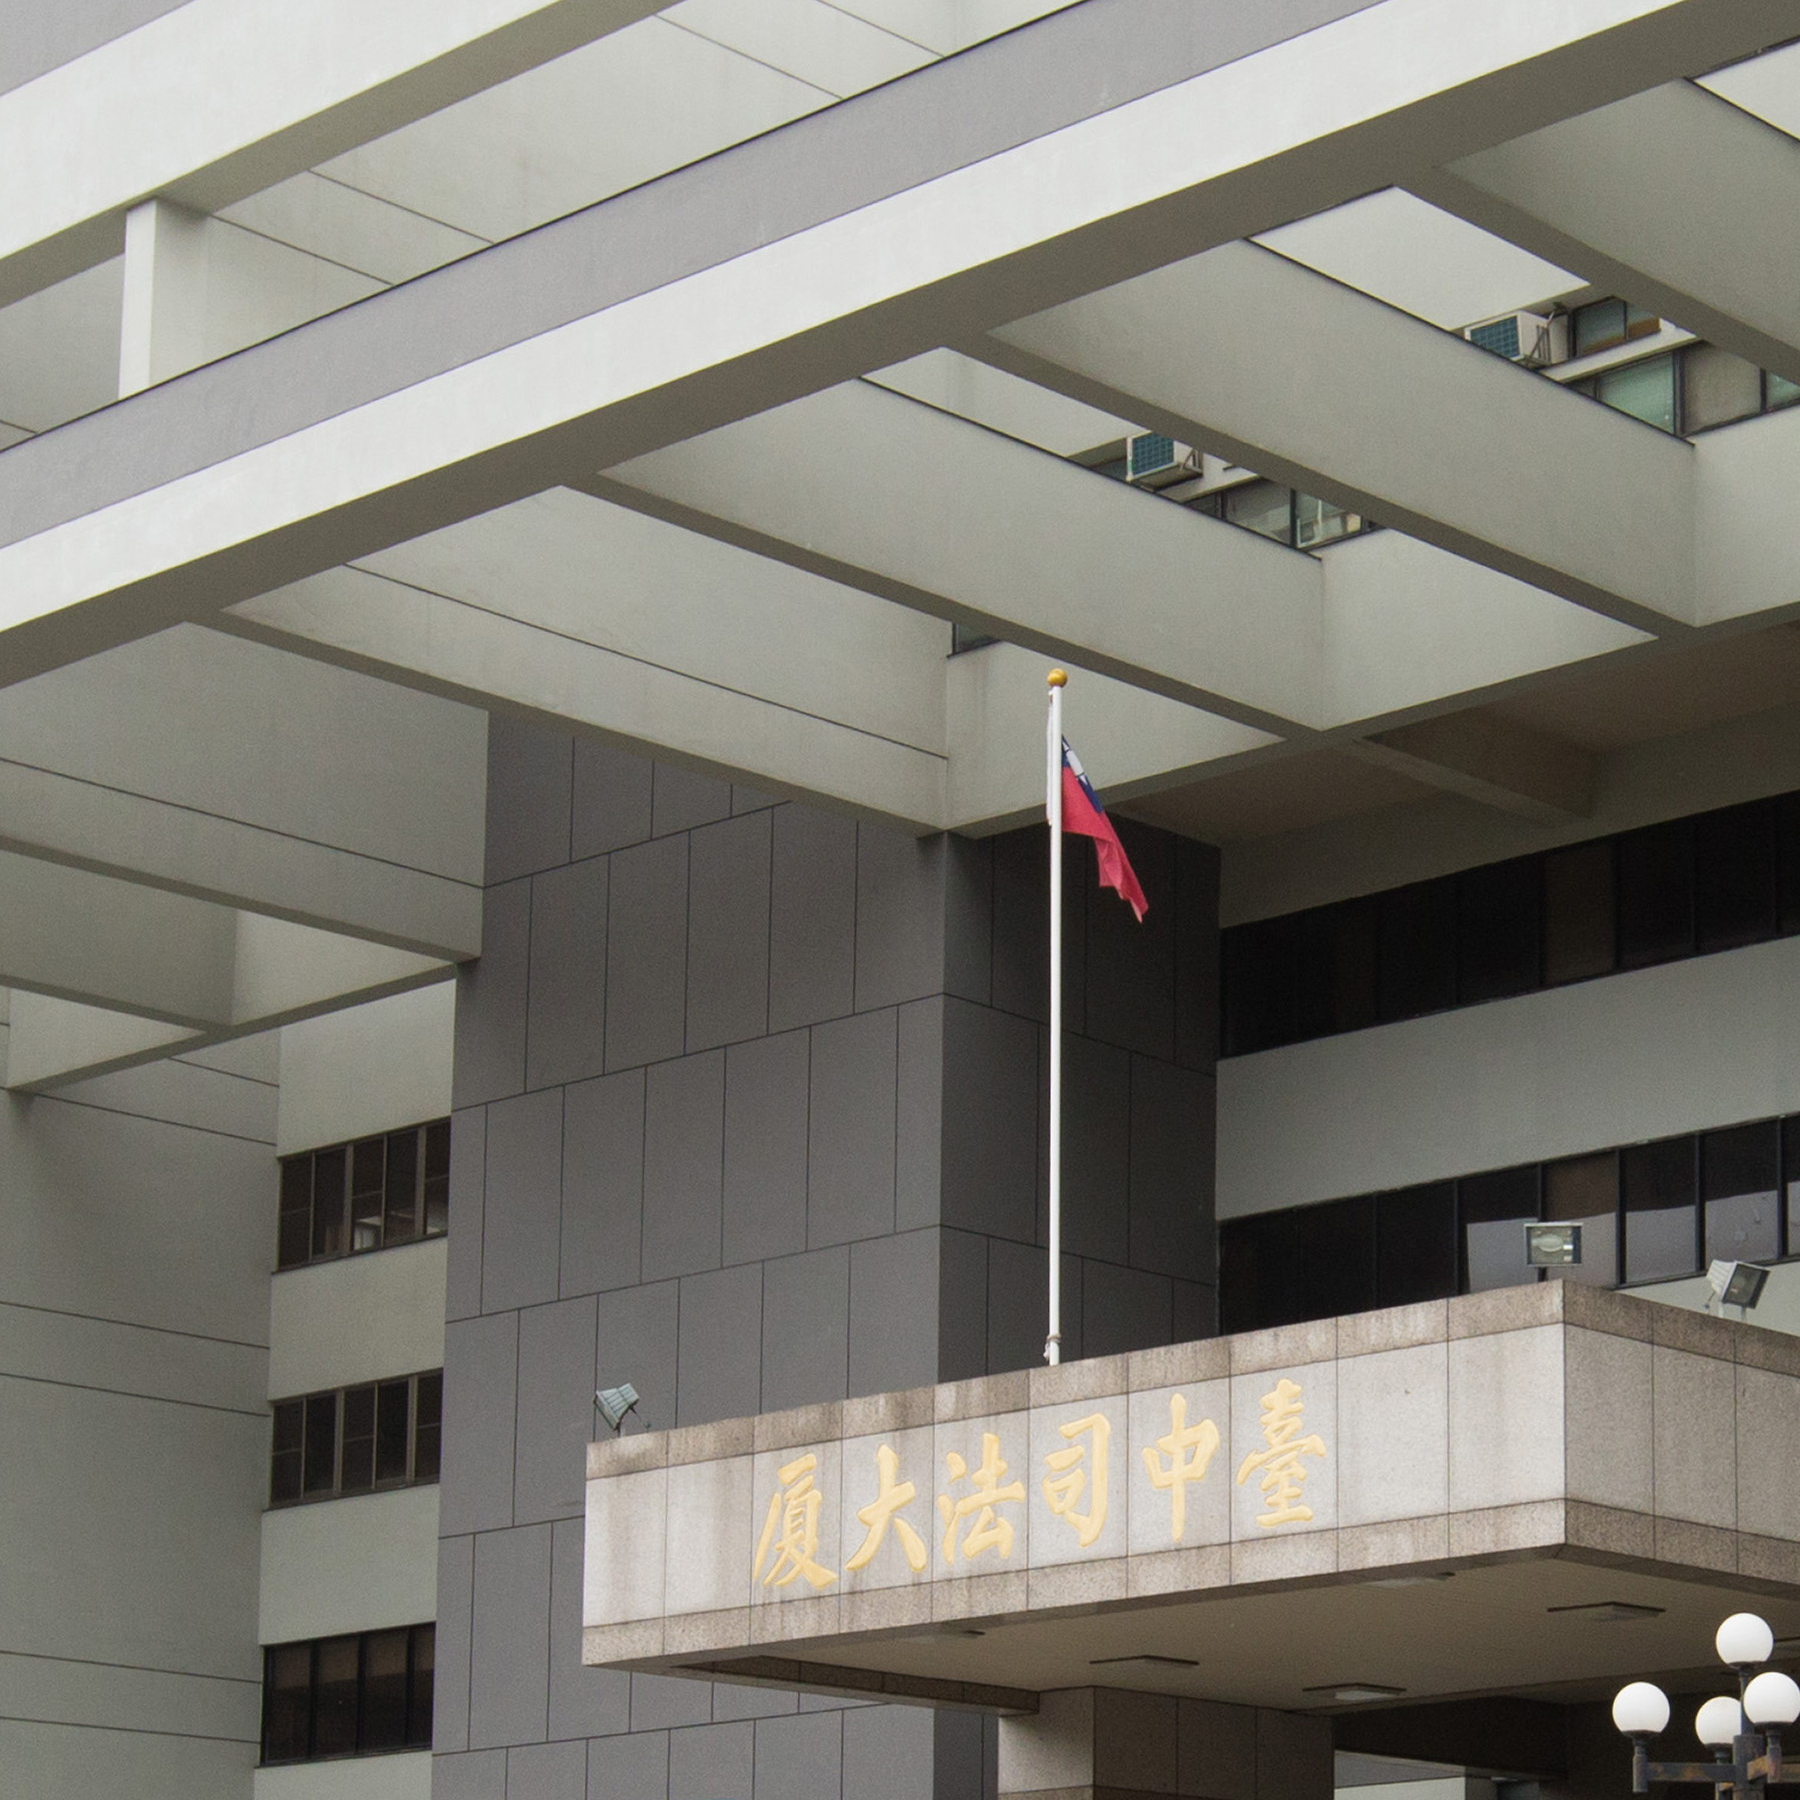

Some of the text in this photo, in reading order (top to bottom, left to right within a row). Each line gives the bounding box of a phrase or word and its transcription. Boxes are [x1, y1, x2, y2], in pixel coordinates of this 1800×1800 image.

[752, 1378, 1327, 1589] 臺中司法大廈
